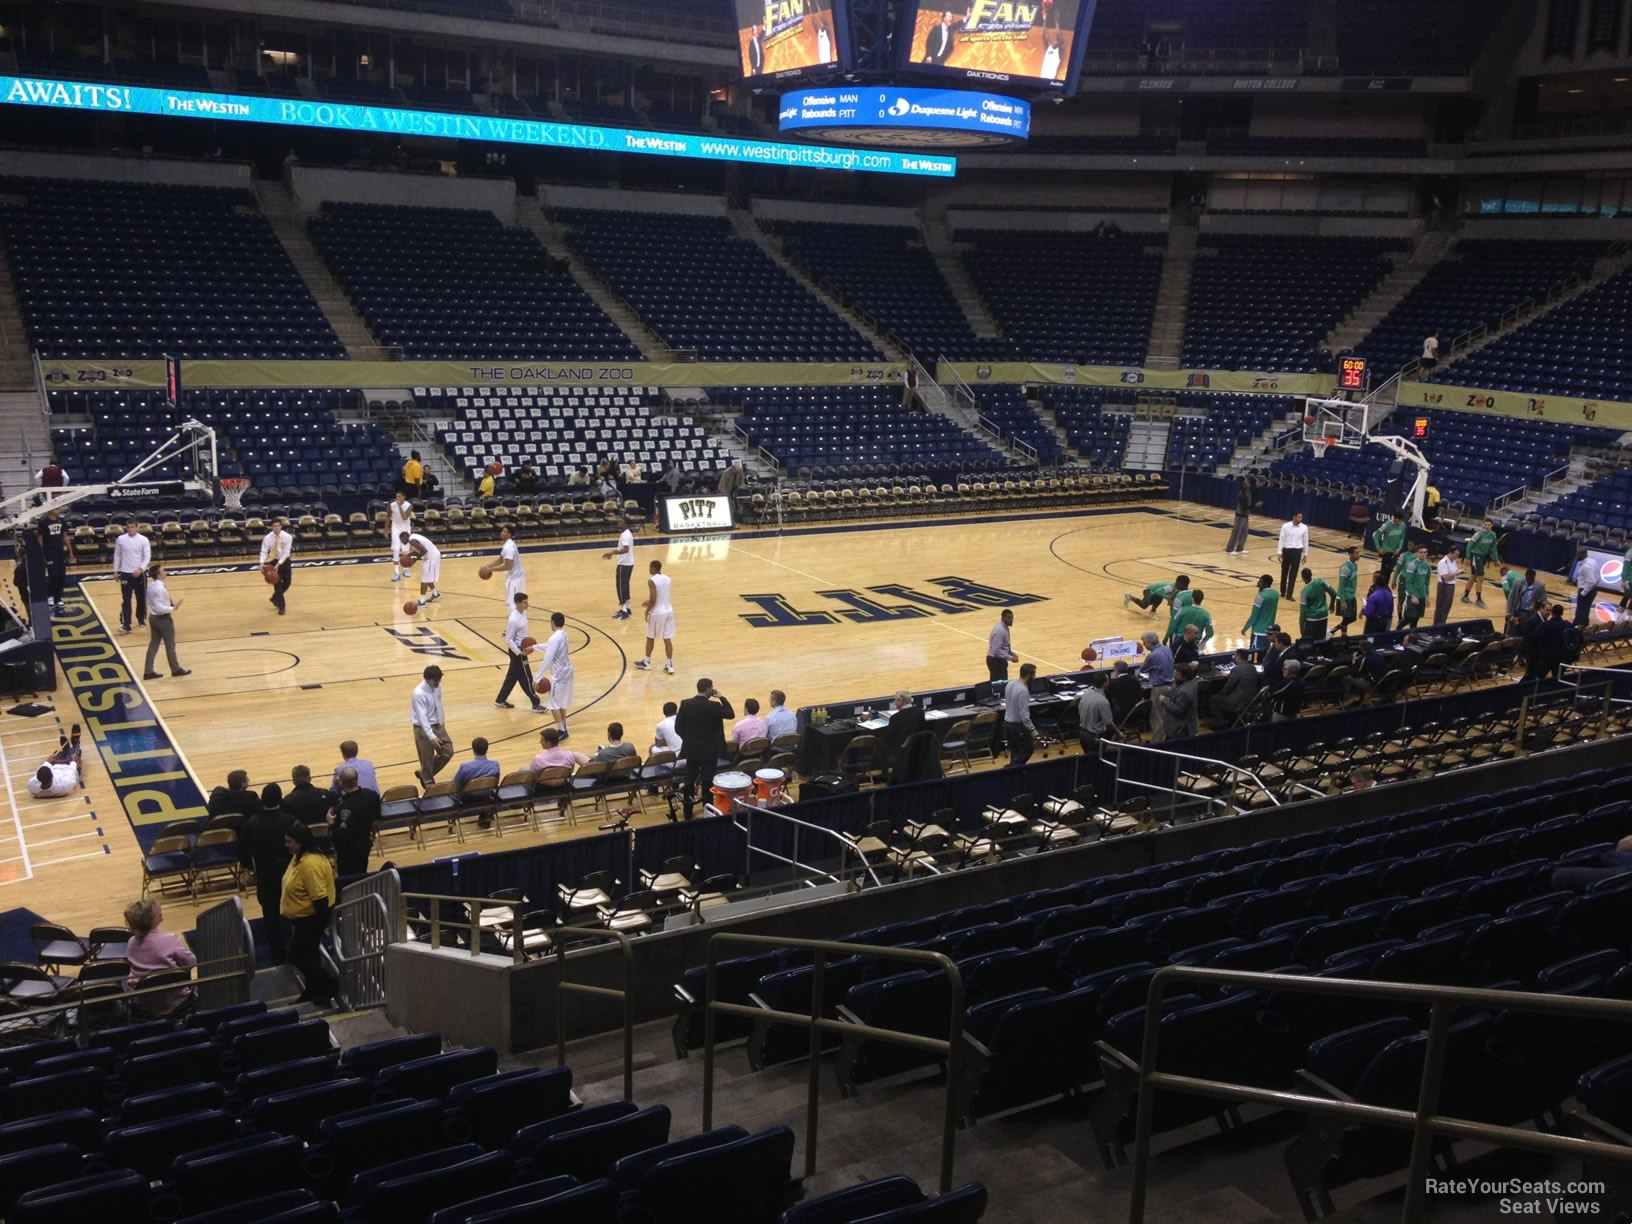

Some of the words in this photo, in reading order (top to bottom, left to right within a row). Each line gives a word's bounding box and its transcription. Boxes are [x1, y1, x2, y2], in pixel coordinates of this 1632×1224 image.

[764, 0, 804, 37] FAN
[966, 0, 1038, 30] FAN
[966, 70, 1009, 81] DAKTRONICS
[1367, 80, 1385, 89] ACC
[8, 81, 131, 110] AWAITS!
[802, 96, 836, 107] Offensive
[839, 94, 859, 103] MAN
[879, 94, 886, 103] 0
[167, 96, 195, 112] THE
[195, 99, 250, 116] WESTIN
[801, 108, 837, 119] Rebounds
[839, 109, 857, 118] PITT
[878, 109, 885, 118] 0
[910, 104, 956, 117] Duquesne
[955, 107, 978, 119] Light
[982, 100, 1013, 114] Offensive
[281, 103, 353, 127] BOOK
[361, 107, 378, 129] A
[383, 112, 481, 137] WESTIN
[980, 112, 1013, 127] Rebounds
[624, 134, 647, 148] THE
[646, 137, 686, 152] WESTIN
[701, 142, 892, 169] www.westinpittsburgh.com
[901, 158, 918, 171] THE
[917, 160, 953, 174] WESTIN
[1343, 360, 1364, 370] 60:00
[470, 367, 505, 380] THE
[510, 367, 593, 380] OAKLAND
[598, 367, 634, 380] ZOO
[1344, 370, 1360, 386] 35
[122, 488, 140, 496] State
[140, 487, 159, 495] Farm
[678, 498, 716, 520] PITT
[737, 575, 1053, 628] PITT
[382, 626, 472, 661] ACC
[1110, 646, 1131, 656] SPALDING
